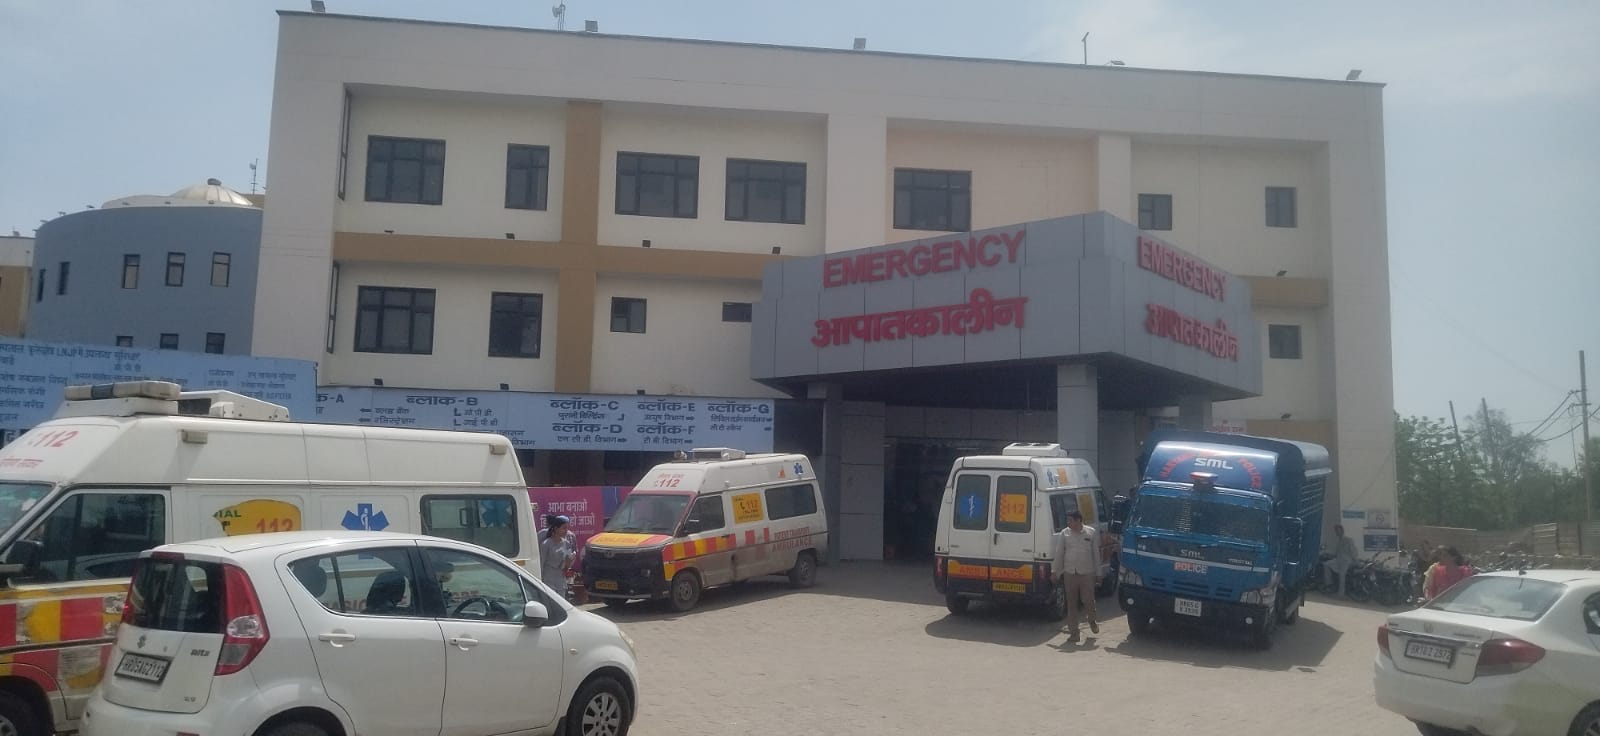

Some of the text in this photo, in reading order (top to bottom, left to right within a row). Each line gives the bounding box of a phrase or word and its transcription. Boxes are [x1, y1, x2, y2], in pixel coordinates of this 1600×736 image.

[823, 230, 1025, 288] EMERGENCY
[1137, 235, 1227, 302] EMERGENCY
[811, 288, 1029, 348] आपातकालीन
[1144, 302, 1238, 362] आपातकालीन
[550, 397, 619, 410] ब्लॉक-C
[637, 398, 695, 412] ब्लॉक-E
[707, 400, 769, 414] ब्लॉक-G
[552, 420, 623, 433] ब्लॉक-D
[636, 422, 695, 435] ब्लॉक-F
[33, 430, 79, 448] 112
[1194, 457, 1233, 470] SML
[660, 479, 680, 488] 112
[1006, 504, 1025, 515] 112
[1174, 561, 1208, 574] POLICE
